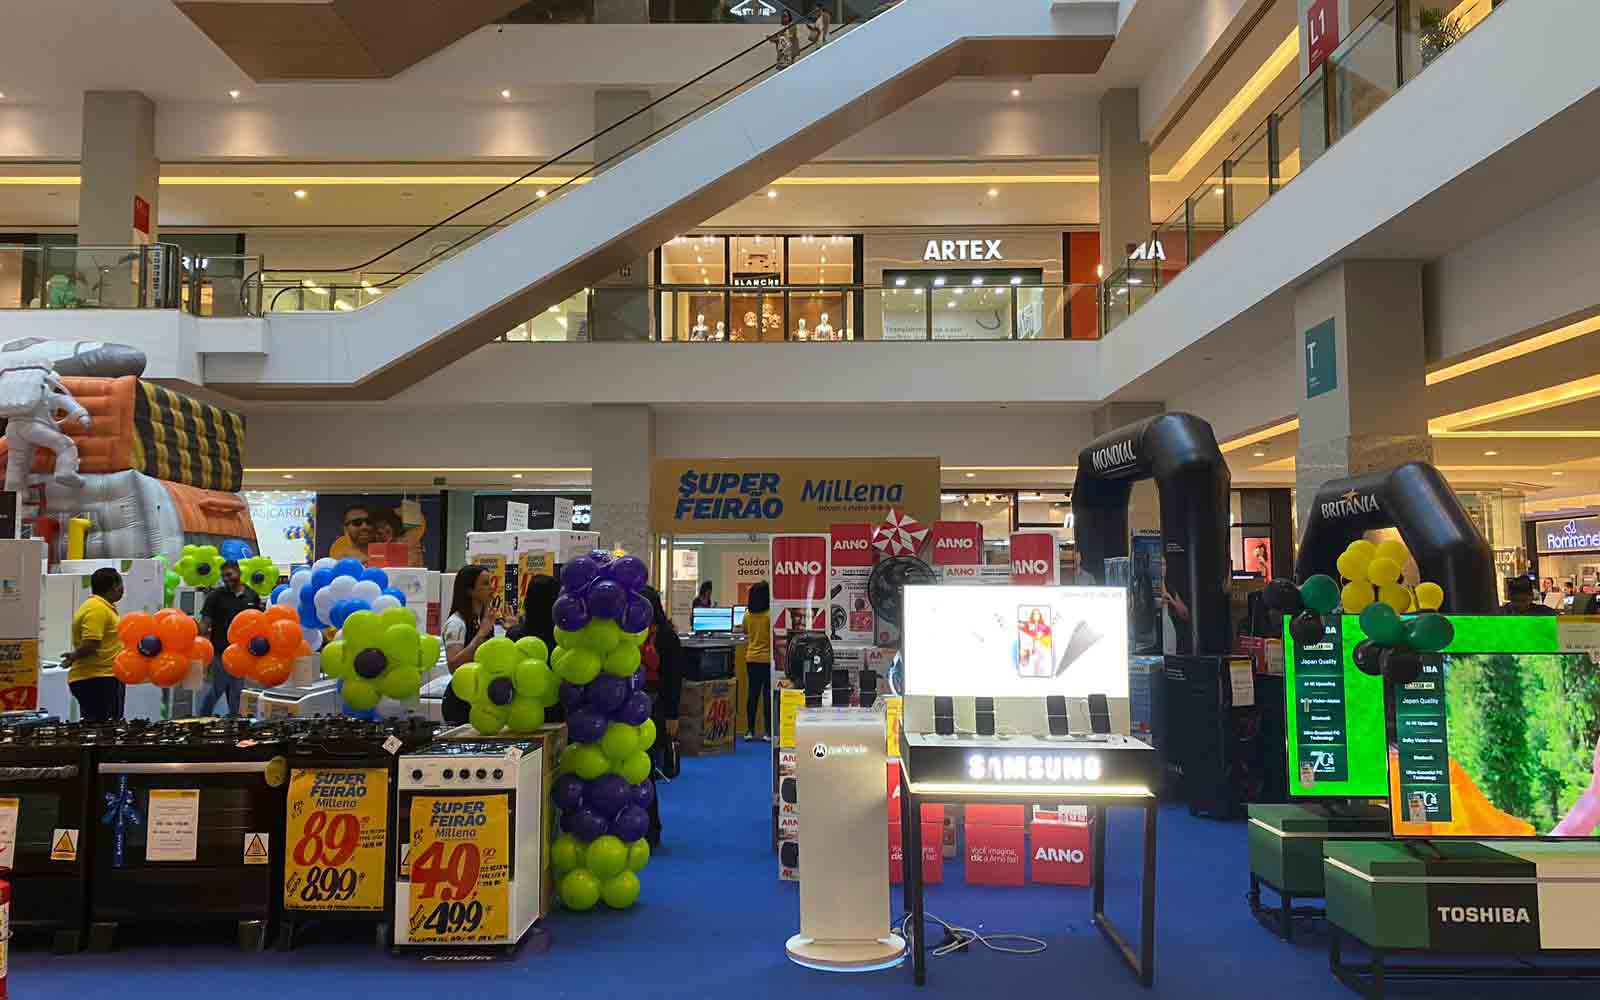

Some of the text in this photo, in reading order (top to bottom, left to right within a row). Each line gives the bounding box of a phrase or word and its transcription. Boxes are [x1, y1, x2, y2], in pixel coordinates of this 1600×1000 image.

[1310, 8, 1325, 45] L1
[923, 239, 1003, 261] ARTEX
[734, 279, 780, 287] BLANCHE
[1306, 341, 1317, 369] T
[1092, 439, 1137, 473] MONDIAL
[801, 479, 904, 502] Millena
[675, 491, 785, 519] FEIRÃO
[834, 540, 869, 551] ARNO
[935, 537, 974, 549] ARNO
[737, 568, 765, 576] desde
[774, 560, 822, 576] ARNO
[1319, 658, 1336, 666] Quality
[1420, 697, 1439, 705] Quality
[315, 799, 357, 808] Millena
[435, 828, 476, 839] Millena
[1034, 847, 1085, 864] ARNO
[1437, 906, 1531, 923] TOSHIBA
